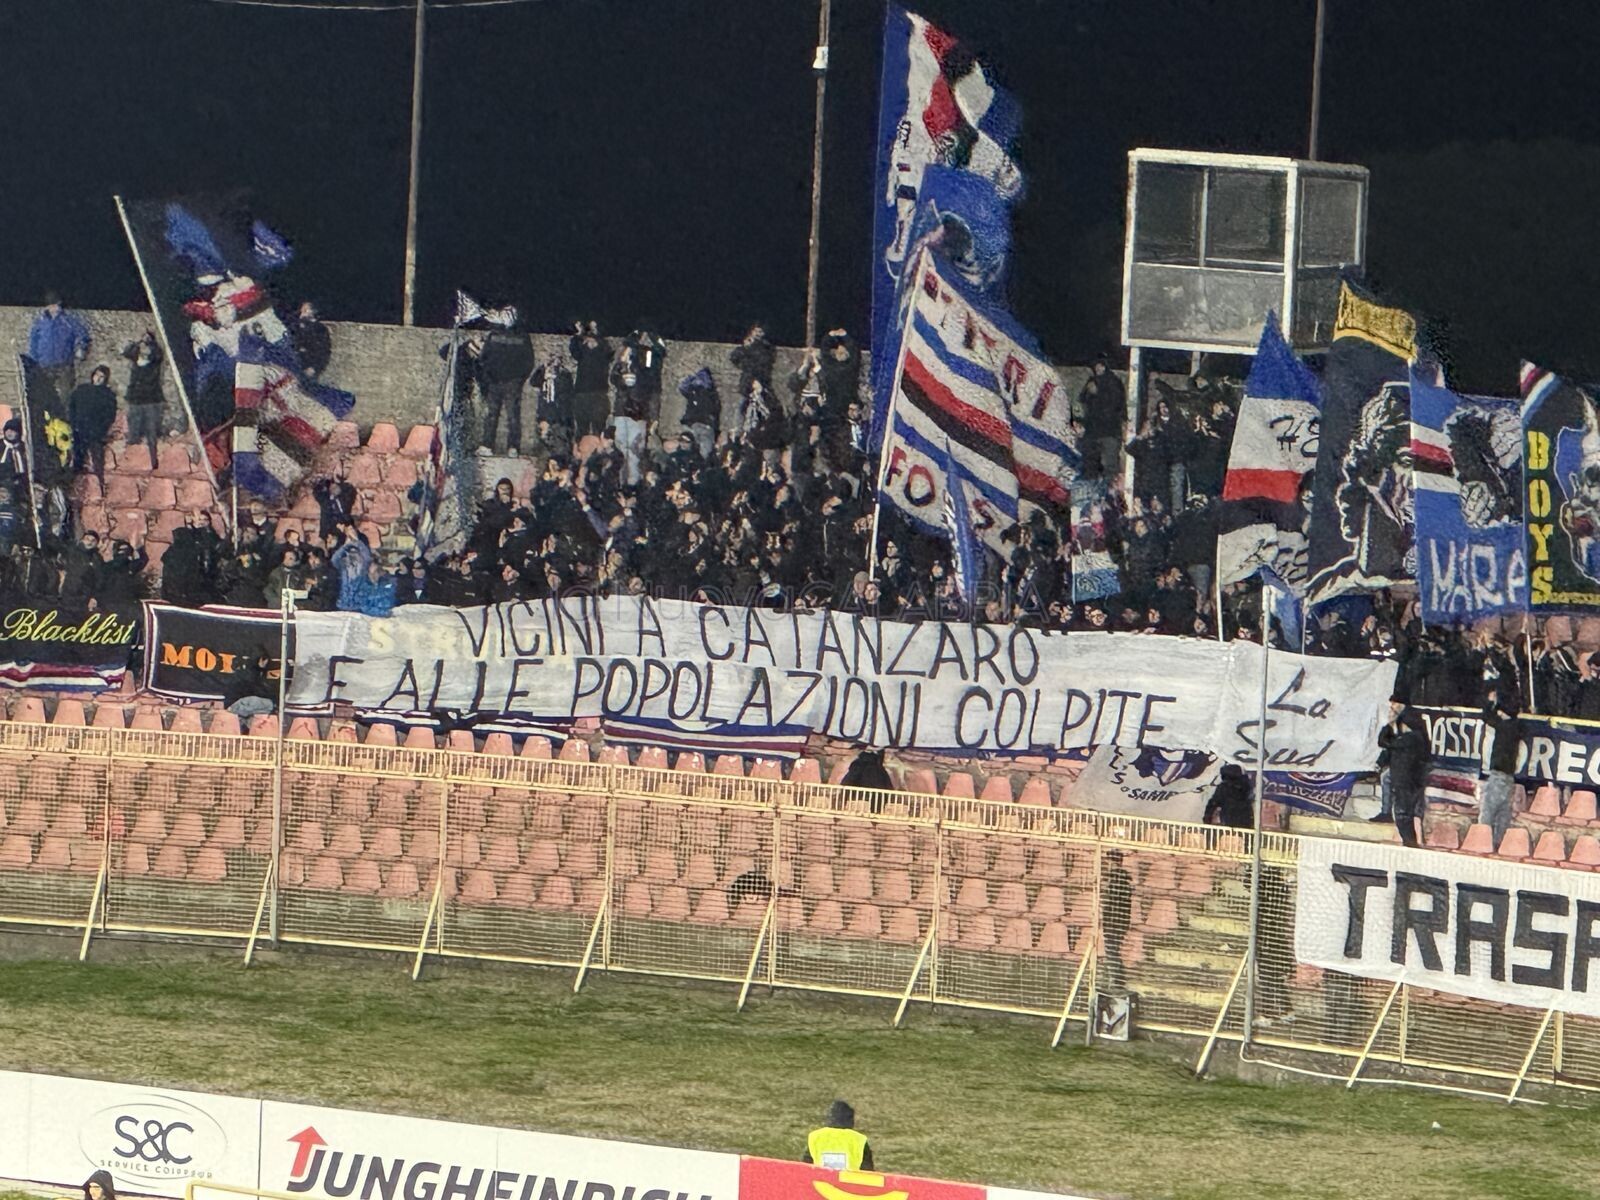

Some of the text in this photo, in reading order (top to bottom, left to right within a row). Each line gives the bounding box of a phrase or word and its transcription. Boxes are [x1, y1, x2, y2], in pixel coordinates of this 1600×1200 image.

[1527, 430, 1554, 605] BOYS
[0, 608, 136, 645] Blacklist
[453, 595, 605, 657] VICINI
[638, 597, 666, 657] A
[700, 604, 1040, 686] CATANZARO
[322, 656, 1177, 750] E ALLE POPOLAZIONI COLPITE
[1267, 667, 1331, 719] La
[1234, 719, 1335, 766] Sud
[113, 1115, 194, 1164] S&C
[286, 1149, 712, 1200] JUNGHEIN
